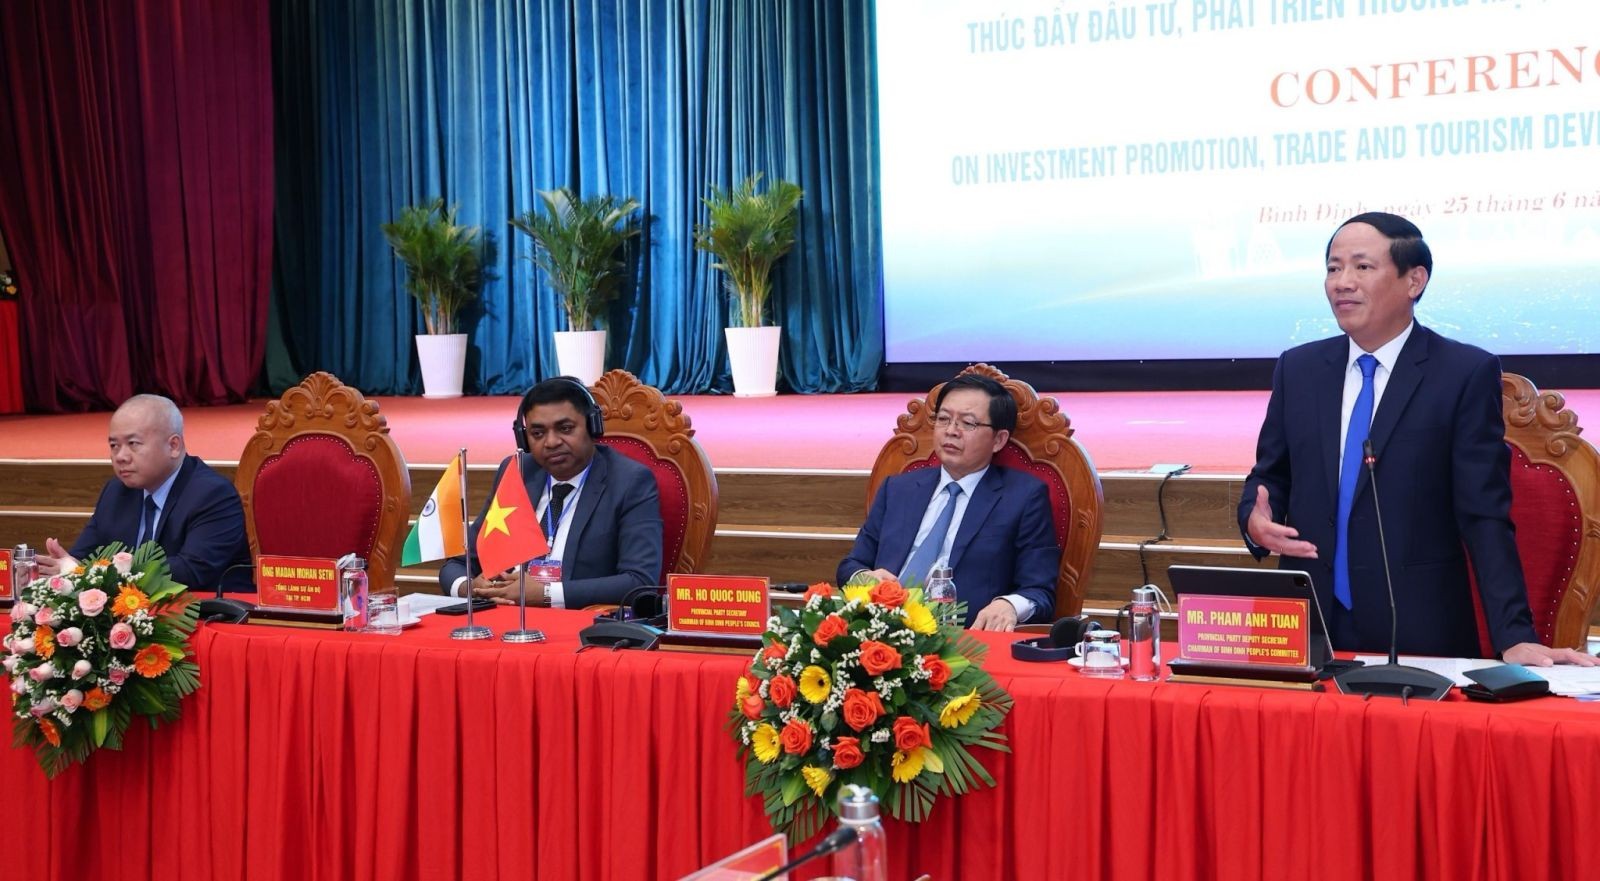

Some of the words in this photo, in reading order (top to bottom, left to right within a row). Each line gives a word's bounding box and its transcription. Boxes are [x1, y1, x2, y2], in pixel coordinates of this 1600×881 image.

[966, 12, 1025, 54] THÚC
[1270, 46, 1600, 108] CONFEREN
[952, 154, 979, 186] ON
[986, 145, 1117, 183] INVESTMENT
[1125, 135, 1265, 176] PROMOTION,
[1273, 129, 1347, 166] TRADE
[1356, 125, 1407, 162] AND
[1415, 115, 1533, 158] TOURISM
[1544, 109, 1600, 149] DEV
[1443, 195, 1469, 214] 25
[1551, 191, 1567, 209] 6
[275, 566, 296, 578] MADAN
[676, 588, 693, 601] MR.
[695, 589, 708, 602] HO
[710, 589, 734, 603] QUOC
[736, 590, 761, 603] DUNG
[691, 608, 713, 616] PROVINCIAL
[726, 609, 747, 617] SECRETARY
[1187, 610, 1207, 625] MR.
[1210, 611, 1242, 627] PHAM
[1245, 613, 1268, 629] ANH
[1271, 614, 1299, 630] TUAN
[1197, 633, 1225, 642] PROVINCIAL
[1226, 634, 1241, 643] PARTY
[1242, 635, 1260, 644] DEPUTY
[1261, 635, 1288, 645] SECRETARY
[1188, 644, 1213, 653] CHAIRMAN
[1213, 645, 1220, 654] OF
[1246, 647, 1270, 657] PEOPLE'S
[1270, 649, 1299, 658] COMMITTEE
